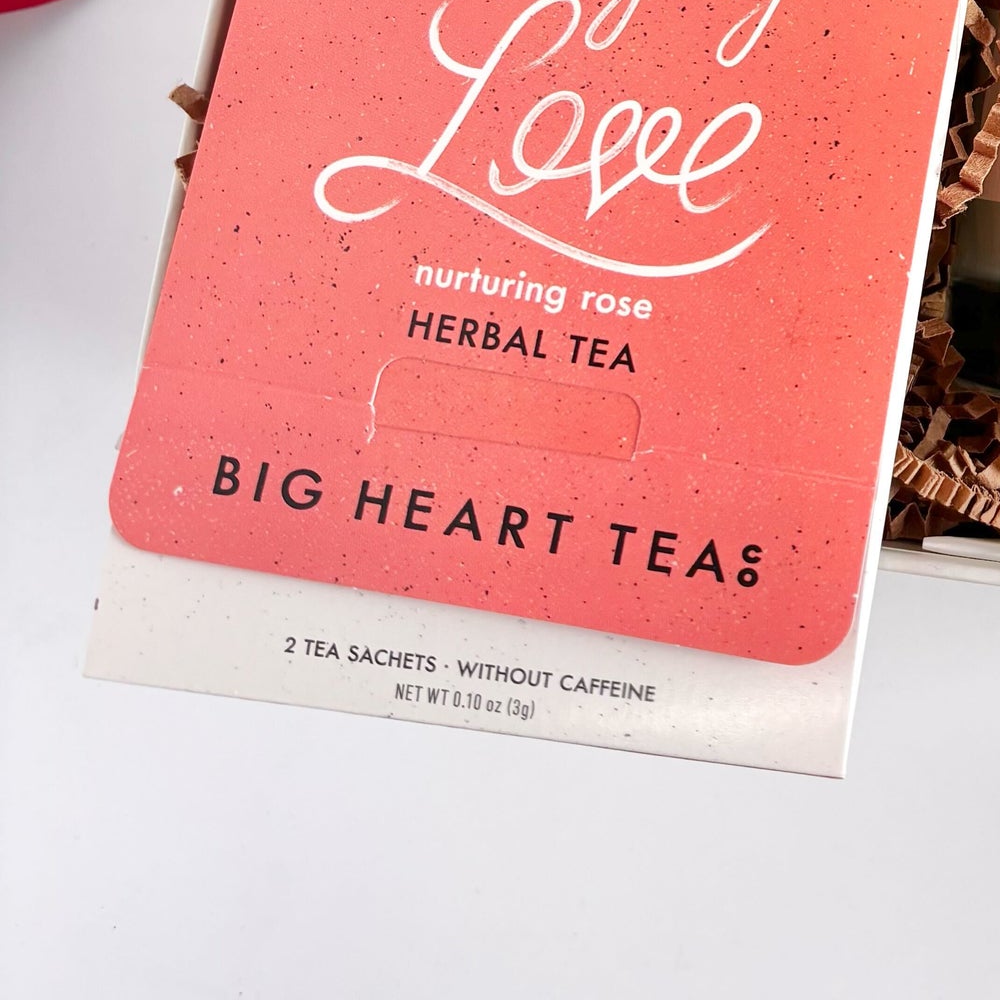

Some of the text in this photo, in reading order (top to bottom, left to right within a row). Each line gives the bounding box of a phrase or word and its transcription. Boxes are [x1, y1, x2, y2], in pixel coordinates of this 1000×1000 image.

[414, 262, 654, 321] nurturing rose
[407, 309, 636, 374] HERBAL TEA
[212, 455, 323, 511] BIG
[353, 480, 574, 555] HEART
[608, 523, 726, 584] TEA
[283, 636, 657, 703] 2 TEA SACHETS WITHOUT CAFFEINE
[394, 683, 536, 721] NET WT 0.10 oz (3g)
